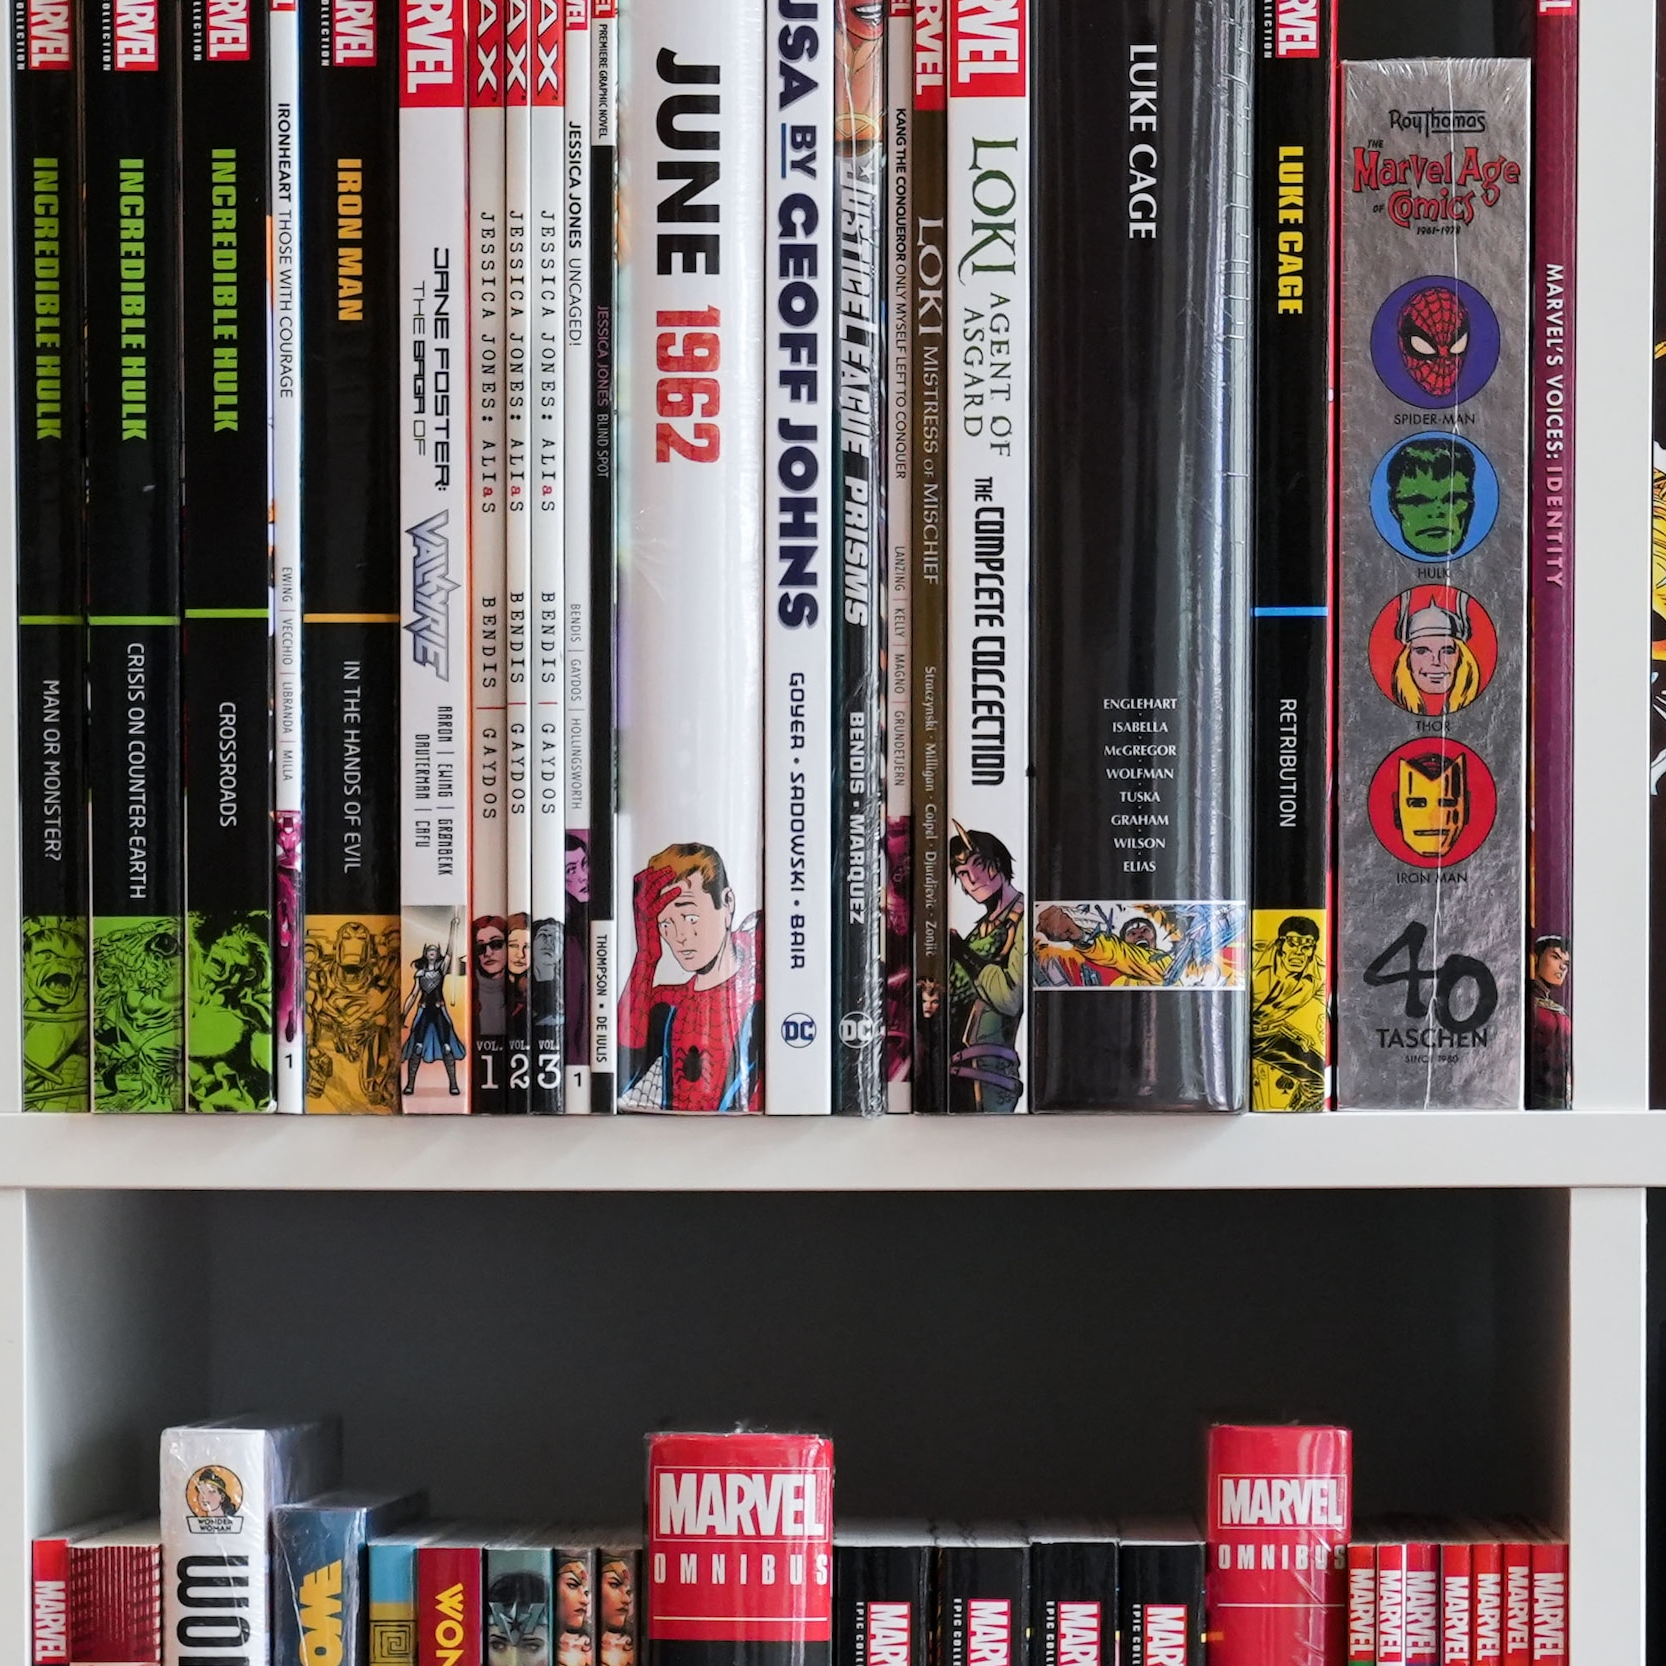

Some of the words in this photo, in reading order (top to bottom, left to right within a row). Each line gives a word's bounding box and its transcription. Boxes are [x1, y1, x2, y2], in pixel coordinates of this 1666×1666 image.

[656, 47, 720, 275] JUNE
[1279, 146, 1303, 223] LUKE
[34, 158, 60, 347] INCREDIBLE
[1278, 231, 1303, 314] CAGE
[1547, 264, 1564, 365] MARVEL'S
[36, 356, 61, 439] HULK
[656, 305, 720, 463] 1962
[1546, 375, 1563, 458] VOICES:
[1545, 466, 1564, 588] IDENTITY
[43, 680, 60, 722] MAN
[43, 729, 60, 754] OR
[1280, 699, 1297, 826] RETRIBUTION
[44, 761, 61, 861] MONSTER?
[1376, 1027, 1488, 1049] TASCHEN
